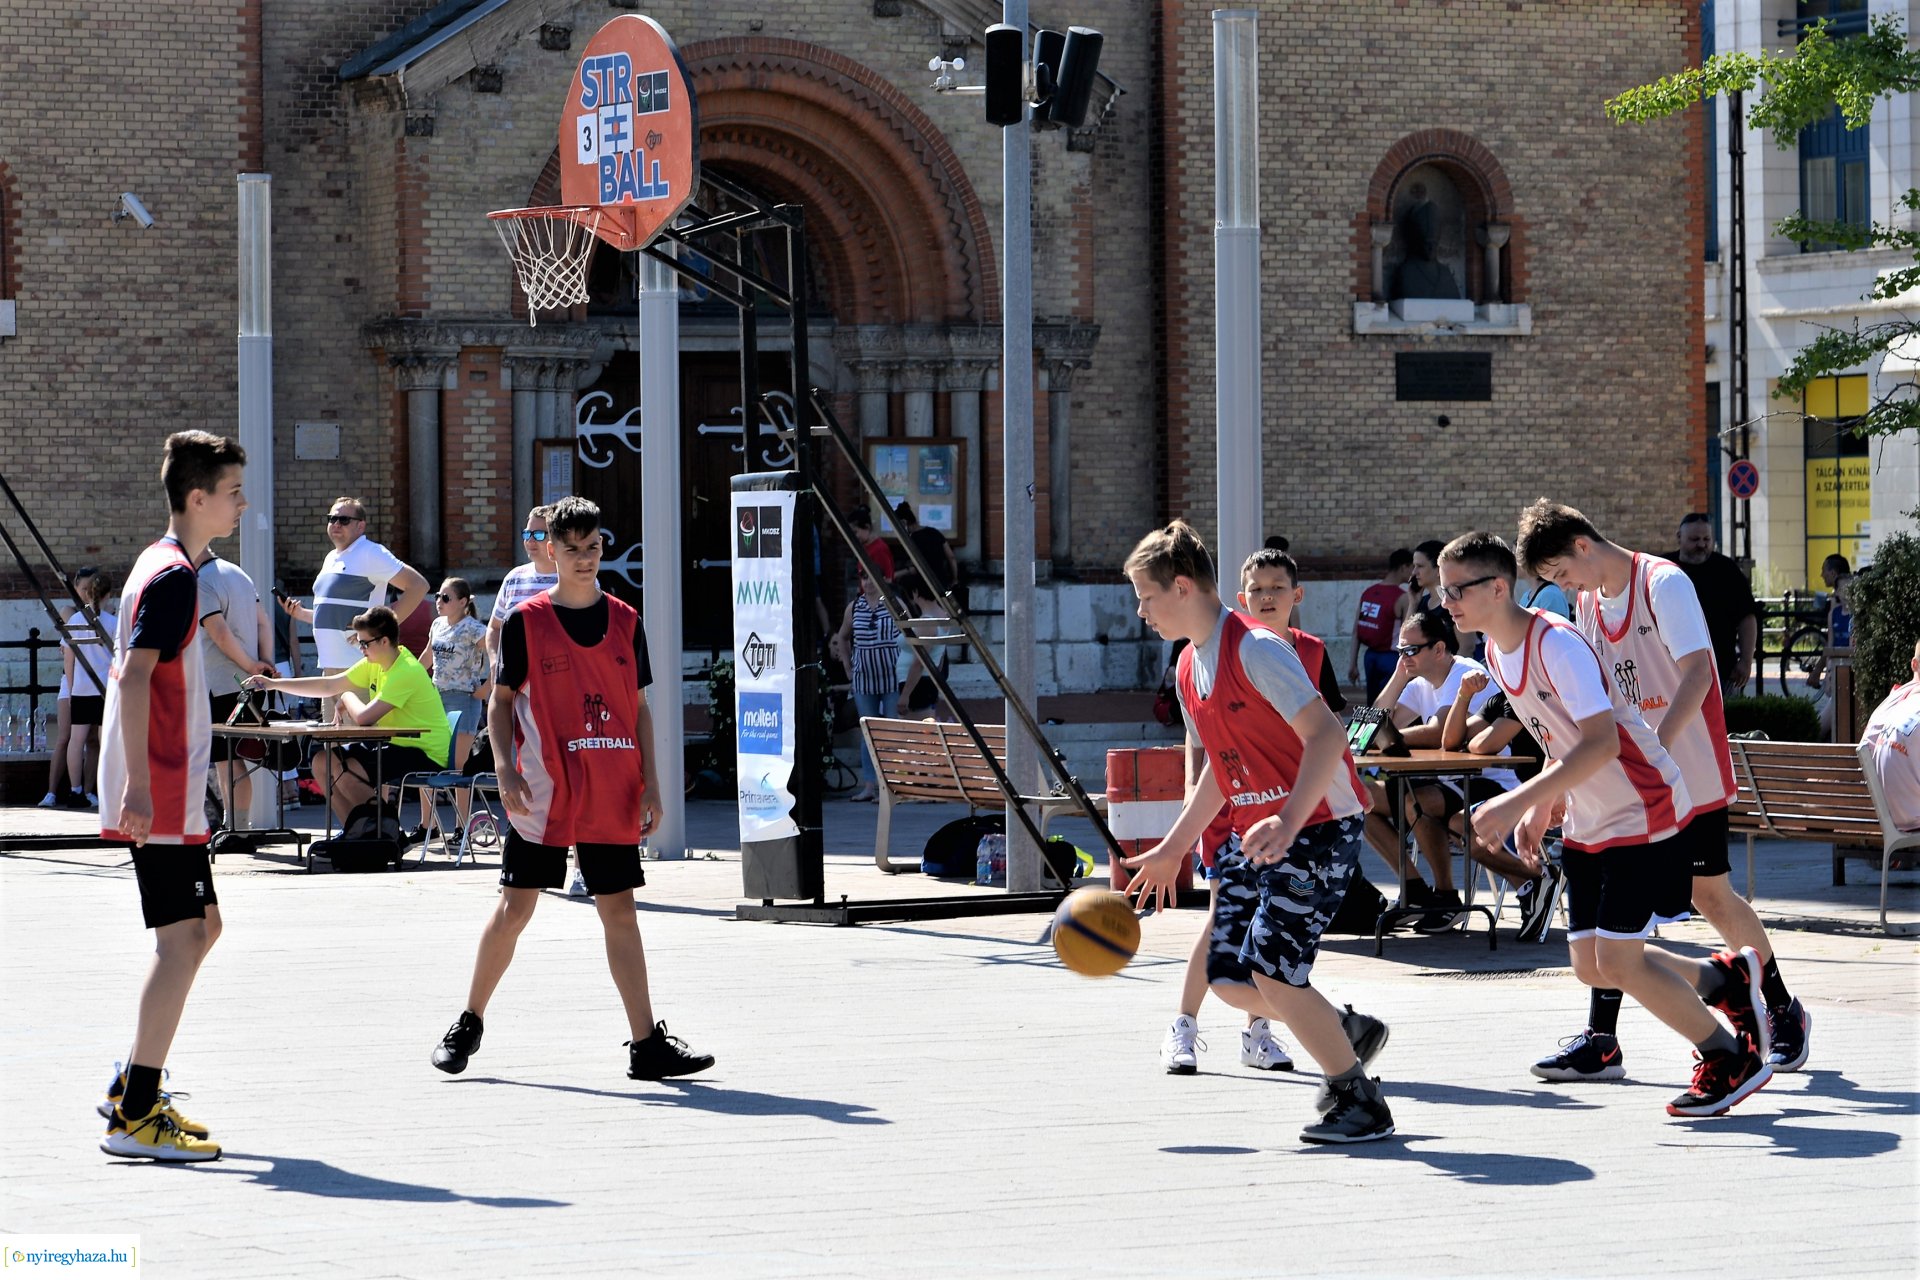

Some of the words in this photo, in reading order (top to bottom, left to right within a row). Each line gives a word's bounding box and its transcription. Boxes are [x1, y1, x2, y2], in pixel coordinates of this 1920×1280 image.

[581, 53, 632, 109] STR
[583, 126, 592, 152] 3
[600, 148, 670, 205] BALL
[1815, 482, 1822, 492] A
[737, 580, 780, 605] MVM
[750, 643, 777, 669] TOTI
[1639, 695, 1668, 711] ALL
[743, 708, 778, 727] molten
[567, 737, 635, 752] STREETBALL
[1229, 785, 1290, 808] REETBALL
